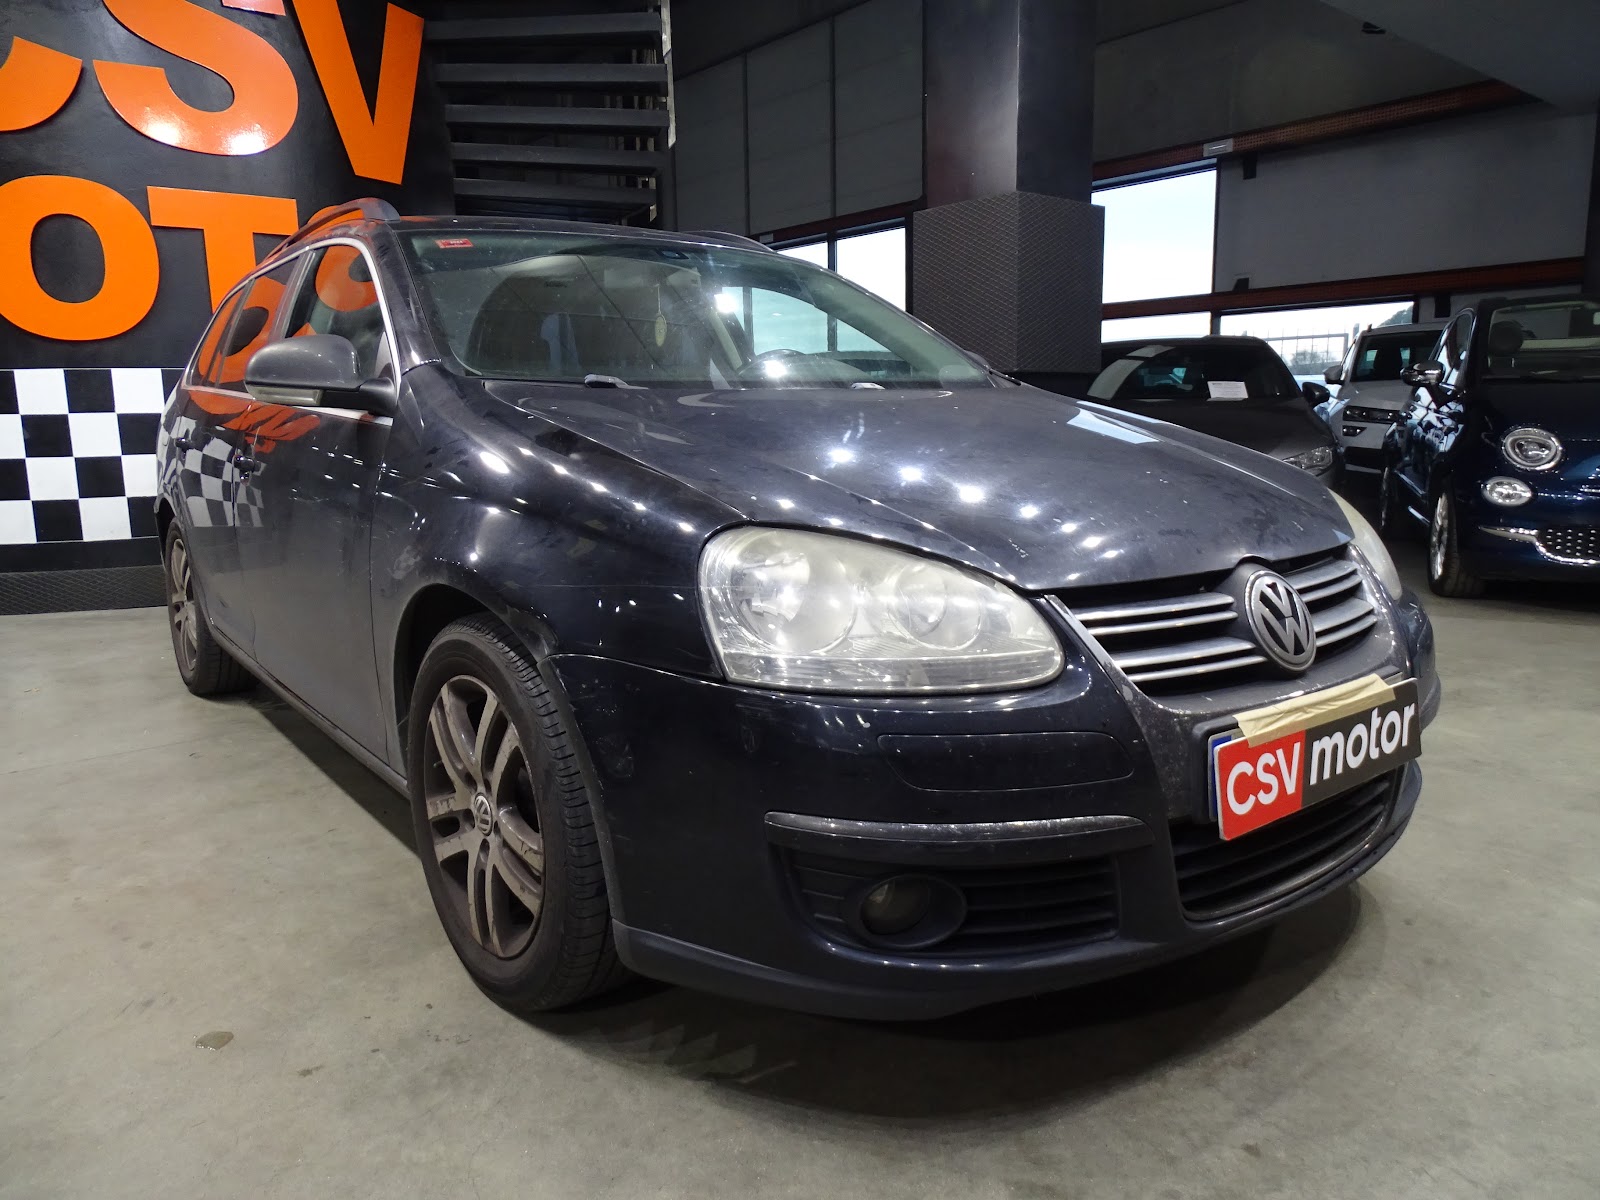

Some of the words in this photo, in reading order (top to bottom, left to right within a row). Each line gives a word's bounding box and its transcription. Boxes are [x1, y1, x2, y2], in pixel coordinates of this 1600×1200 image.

[0, 174, 364, 341] OT
[1226, 741, 1301, 815] CSV
[1309, 702, 1416, 786] motor
